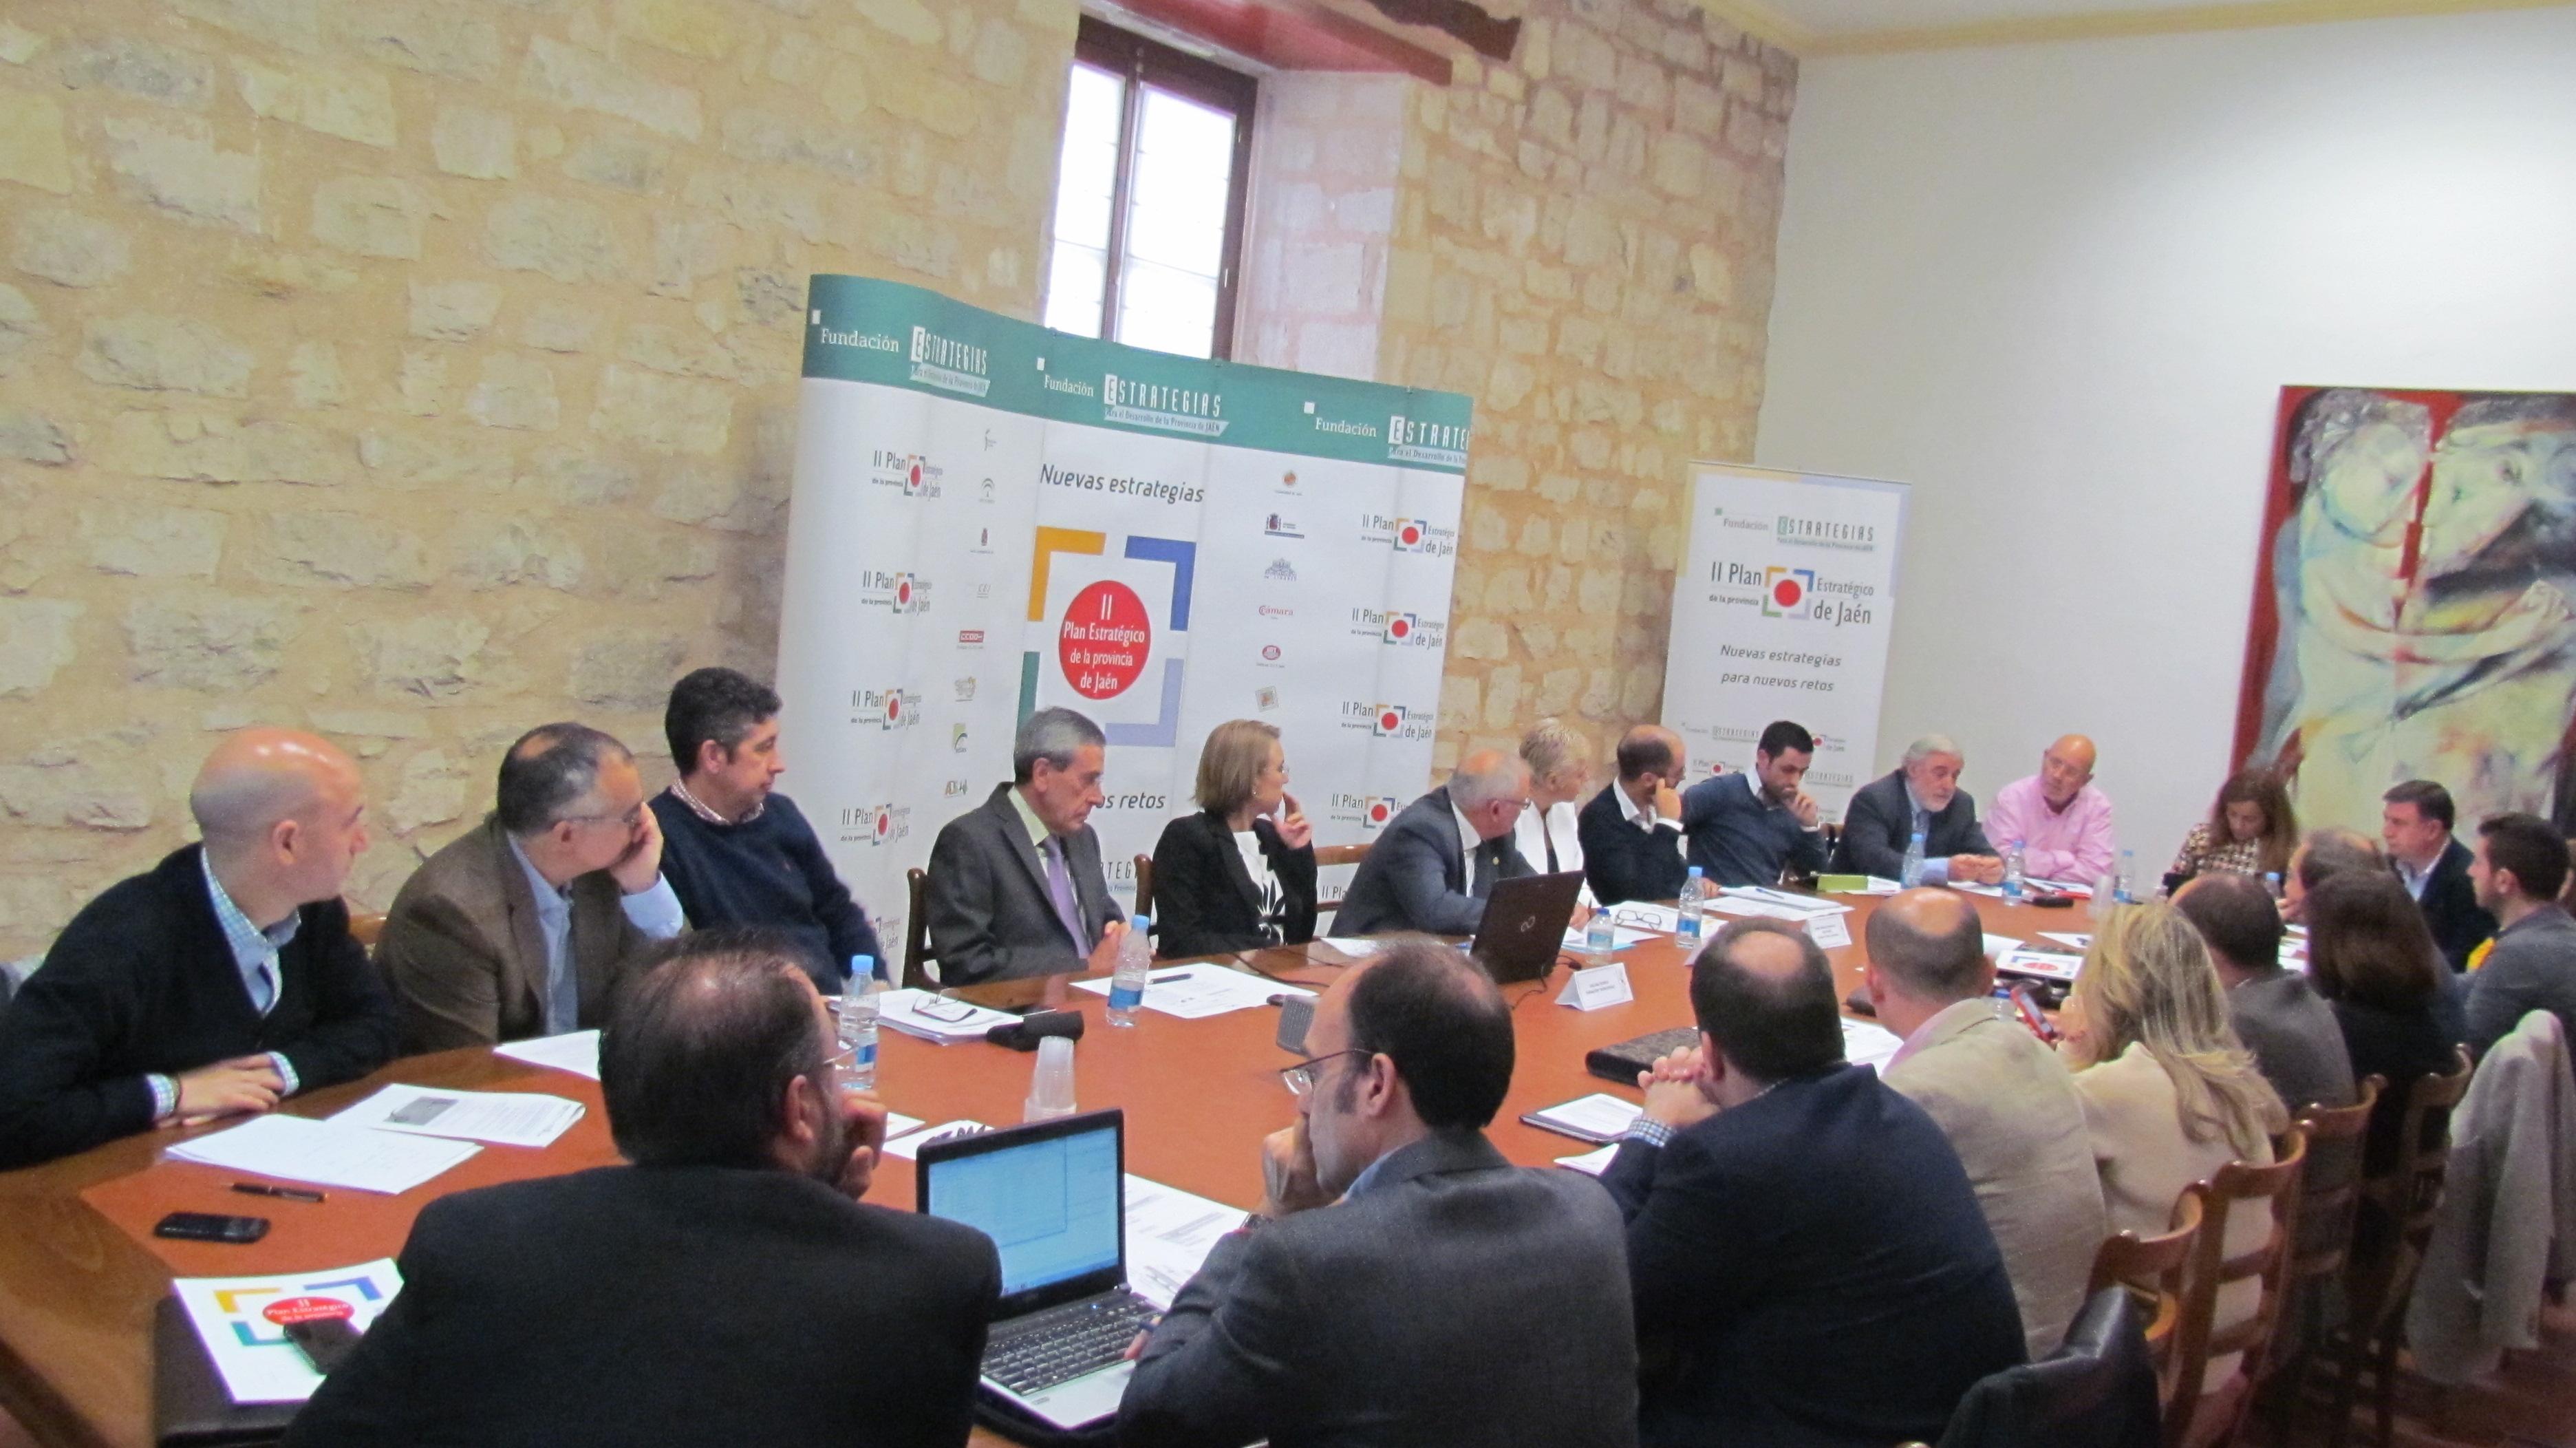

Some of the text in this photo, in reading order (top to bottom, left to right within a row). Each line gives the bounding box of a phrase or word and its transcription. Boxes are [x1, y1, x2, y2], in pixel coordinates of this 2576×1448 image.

[821, 328, 899, 352] Fundación
[1044, 374, 1094, 396] Fundación
[1104, 374, 1221, 417] ESTRATEGIAS
[1126, 410, 1154, 423] Desarrollo
[1171, 417, 1196, 430] Provincia
[1316, 417, 1377, 437] Fundación
[874, 450, 906, 470] II Plan
[1040, 463, 1205, 504] Nuevas estrategias
[1362, 514, 1369, 528] II
[1373, 515, 1394, 531] Plan
[1724, 518, 1768, 531] Fundación
[1777, 515, 1874, 542] ESTRATEGIAS
[1426, 540, 1437, 553] de
[863, 571, 871, 588] II
[875, 572, 894, 589] Plan
[1711, 562, 1874, 599] II Plan Estratégico
[1101, 594, 1112, 620] II
[1352, 608, 1359, 621] II
[1363, 609, 1384, 624] Plan
[1814, 599, 1832, 619] de
[1835, 601, 1871, 626] Jaén
[1064, 621, 1145, 647] Plan Estratégico
[1415, 633, 1426, 646] de
[1071, 648, 1133, 669] de la provincia
[1721, 645, 1842, 668] Nuevas estrategias
[1080, 671, 1117, 694] de Jaén
[1721, 673, 1835, 692] para nuevos retos
[852, 690, 860, 707] II
[865, 690, 884, 707] Plan
[1342, 701, 1349, 714] II
[1353, 702, 1373, 716] Plan
[1405, 725, 1415, 738] de
[1119, 791, 1166, 809] retos
[1332, 793, 1363, 809] II Plan
[842, 809, 850, 824] II
[855, 808, 873, 824] Plan
[1322, 886, 1346, 899] II Pla
